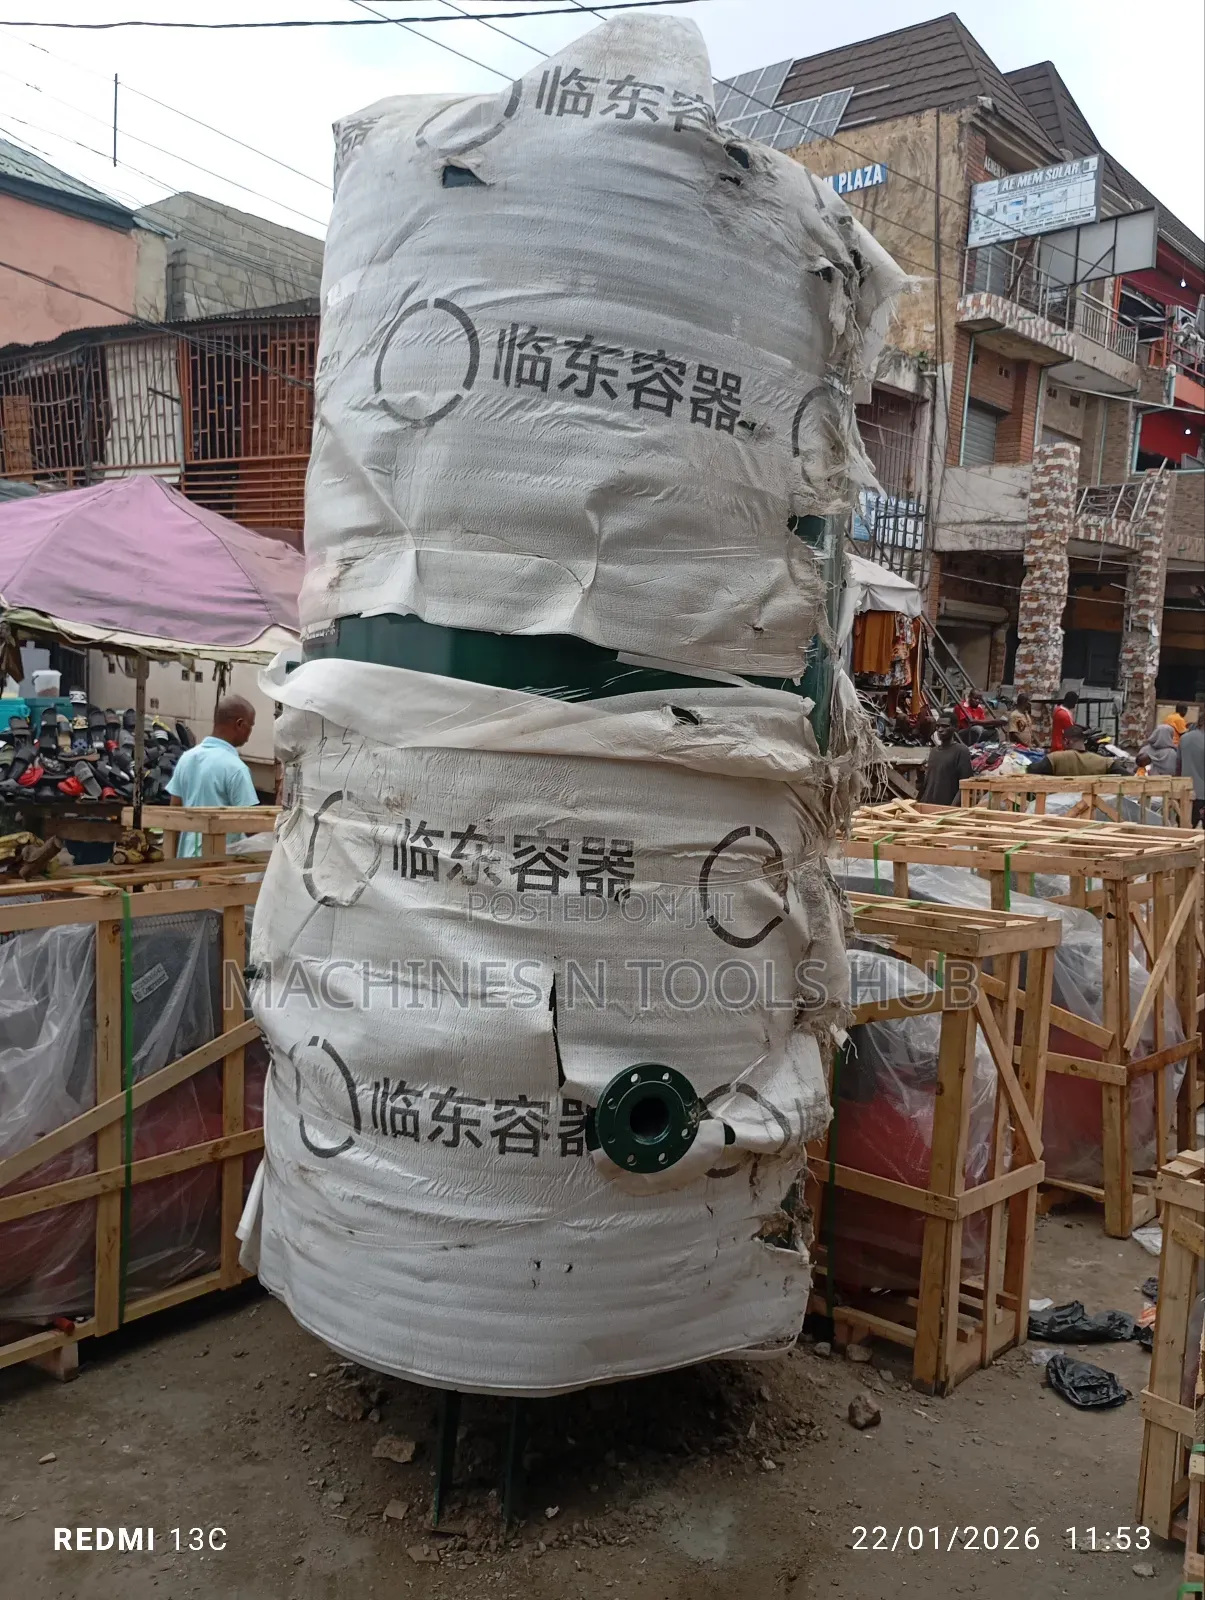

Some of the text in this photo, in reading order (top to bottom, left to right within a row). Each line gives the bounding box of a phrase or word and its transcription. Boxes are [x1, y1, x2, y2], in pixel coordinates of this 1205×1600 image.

[838, 163, 882, 194] PLAZA
[1017, 173, 1043, 189] MEM
[1045, 162, 1079, 181] SOLAR
[493, 323, 742, 435] 临东容器
[392, 818, 635, 898] 临东容器
